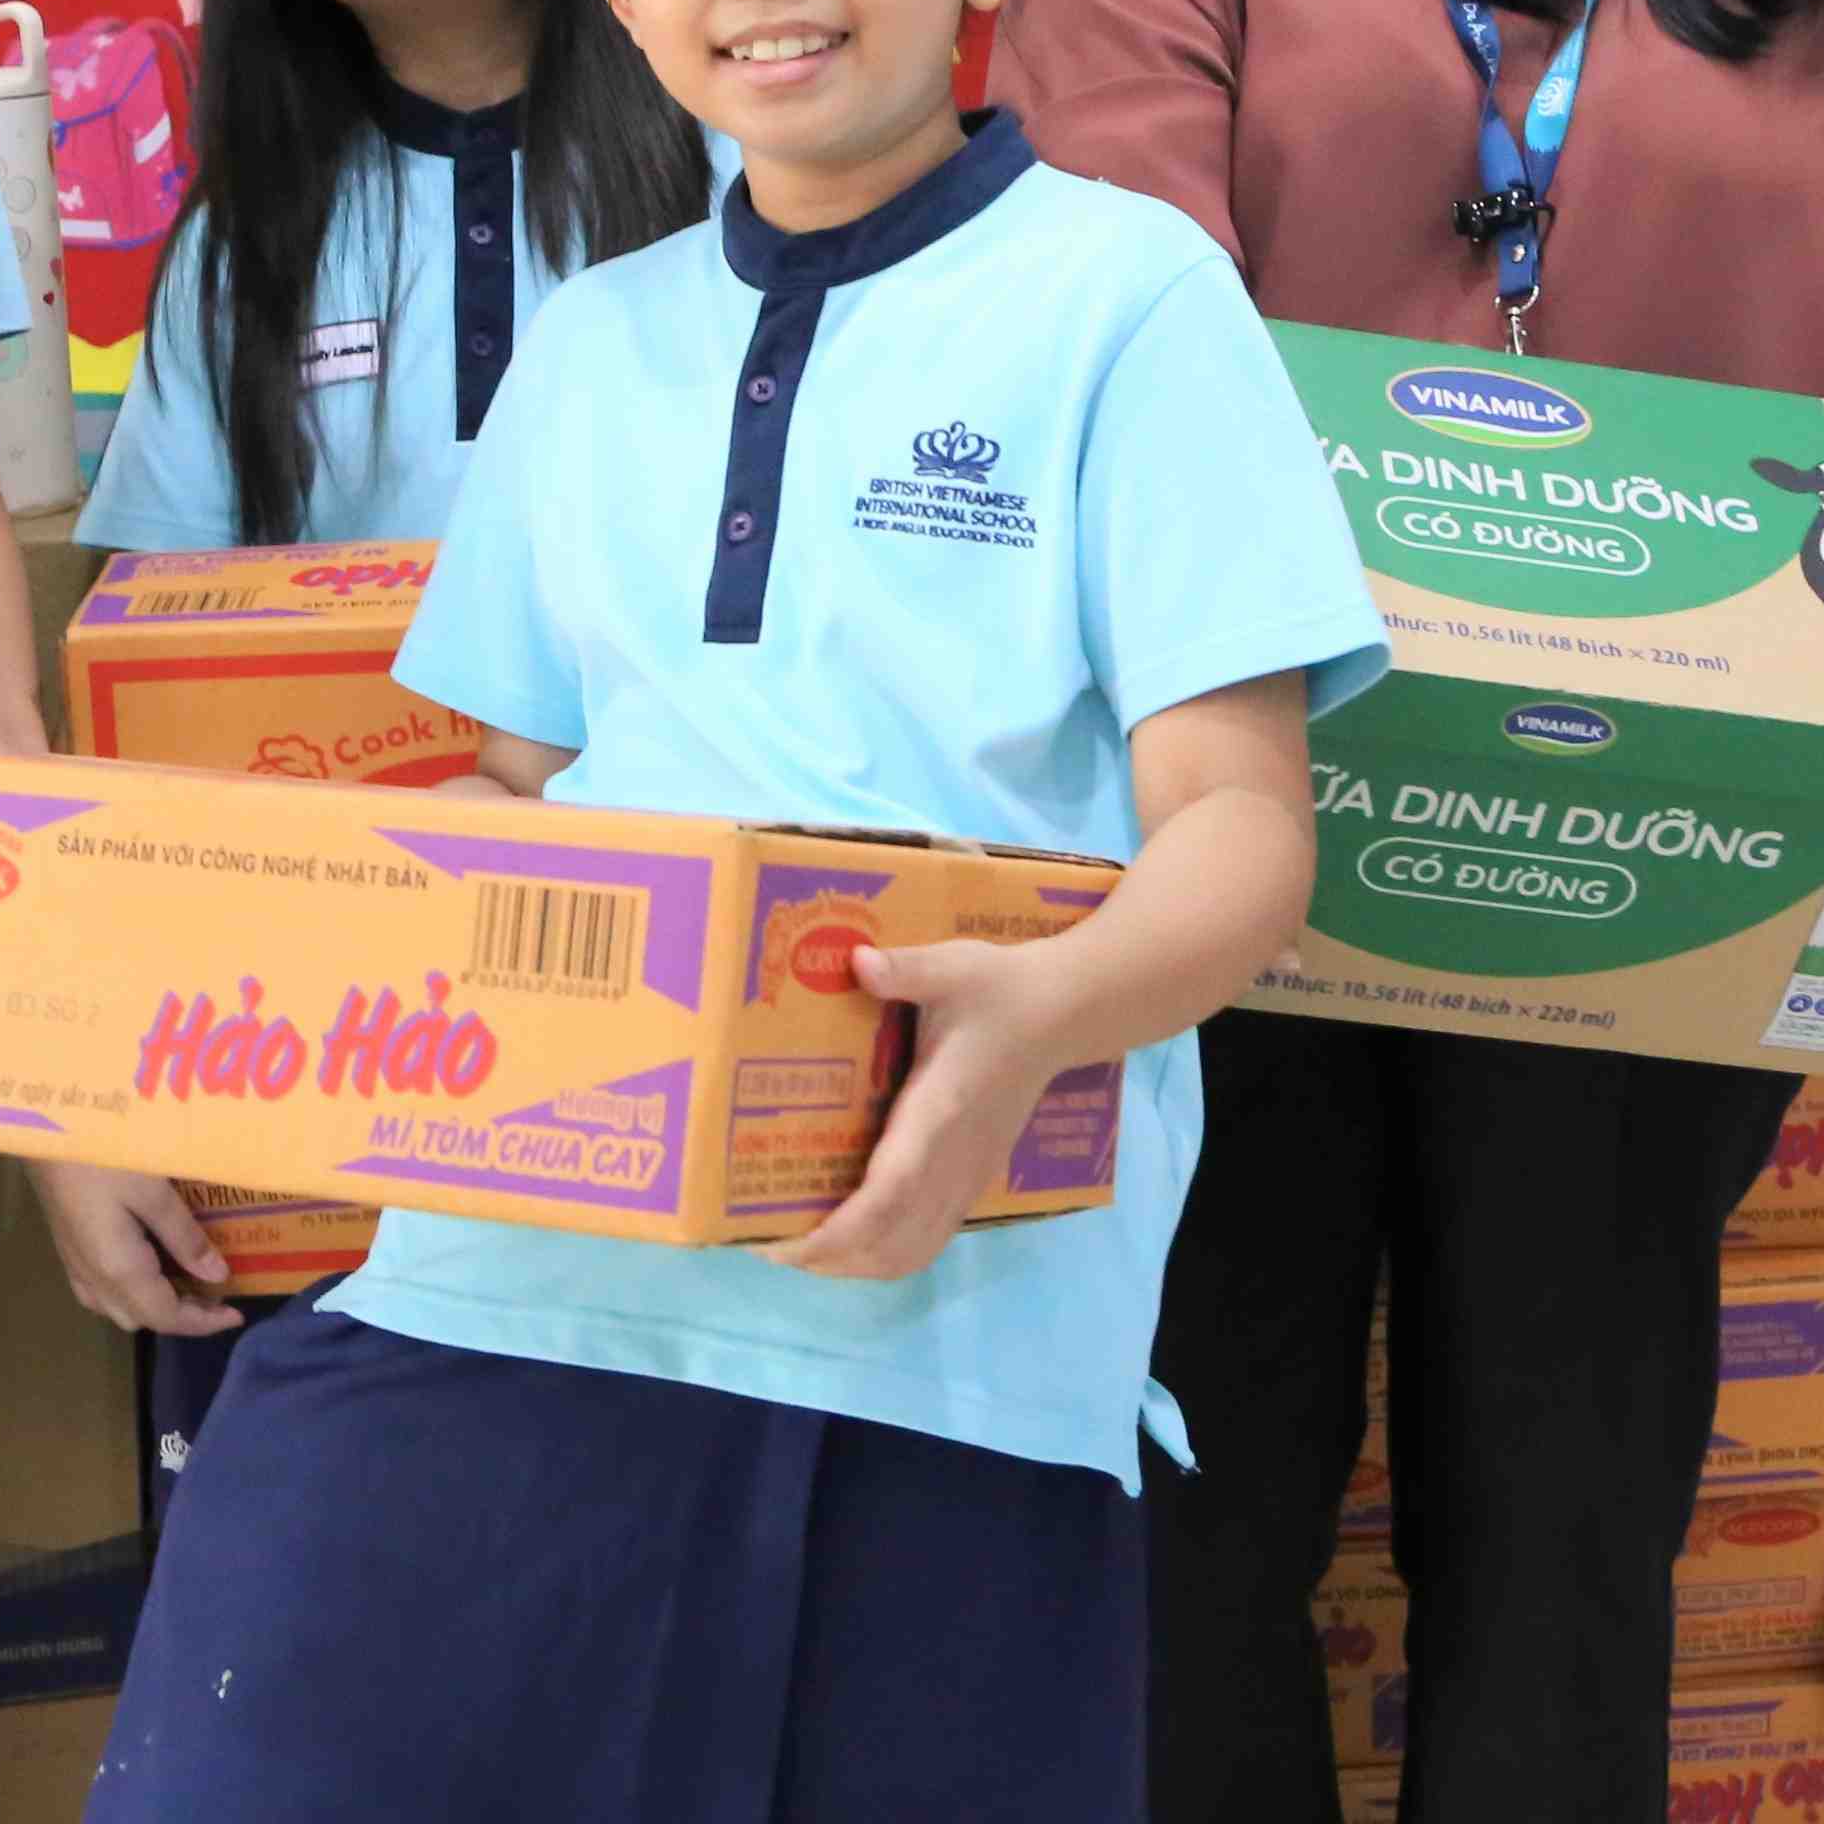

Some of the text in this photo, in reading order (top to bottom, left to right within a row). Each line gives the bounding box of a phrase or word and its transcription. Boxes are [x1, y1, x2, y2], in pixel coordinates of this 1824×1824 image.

[1409, 382, 1571, 427] VINAMILK
[855, 497, 1038, 533] INTERNATIONAL SCHOOL
[870, 478, 1029, 511] BRITISH VIETNAMESE
[1381, 450, 1527, 501] DINH
[1543, 472, 1759, 533] DƯỠNG
[929, 526, 991, 543] EDUCATION
[993, 532, 1035, 549] SCHOOL
[1403, 511, 1628, 564] CÓ ĐƯỜNG
[1510, 627, 1533, 647] lít
[1537, 632, 1572, 653] (48
[1578, 636, 1623, 661] bịch
[1651, 648, 1690, 668] 220
[1696, 654, 1731, 674] ml)
[335, 711, 437, 765] Cook
[1516, 714, 1604, 740] VINAMILK
[1391, 784, 1785, 869] DINH DƯỠNG
[57, 831, 429, 892] SẢN PHẨM VỚI CÔNG NGHỆ NHẬT BẢN
[135, 976, 308, 1101] Hảo
[316, 969, 499, 1099] Hảo
[421, 1119, 489, 1156] TÔM
[500, 1129, 583, 1170] CHUA
[592, 1139, 658, 1180] CAY
